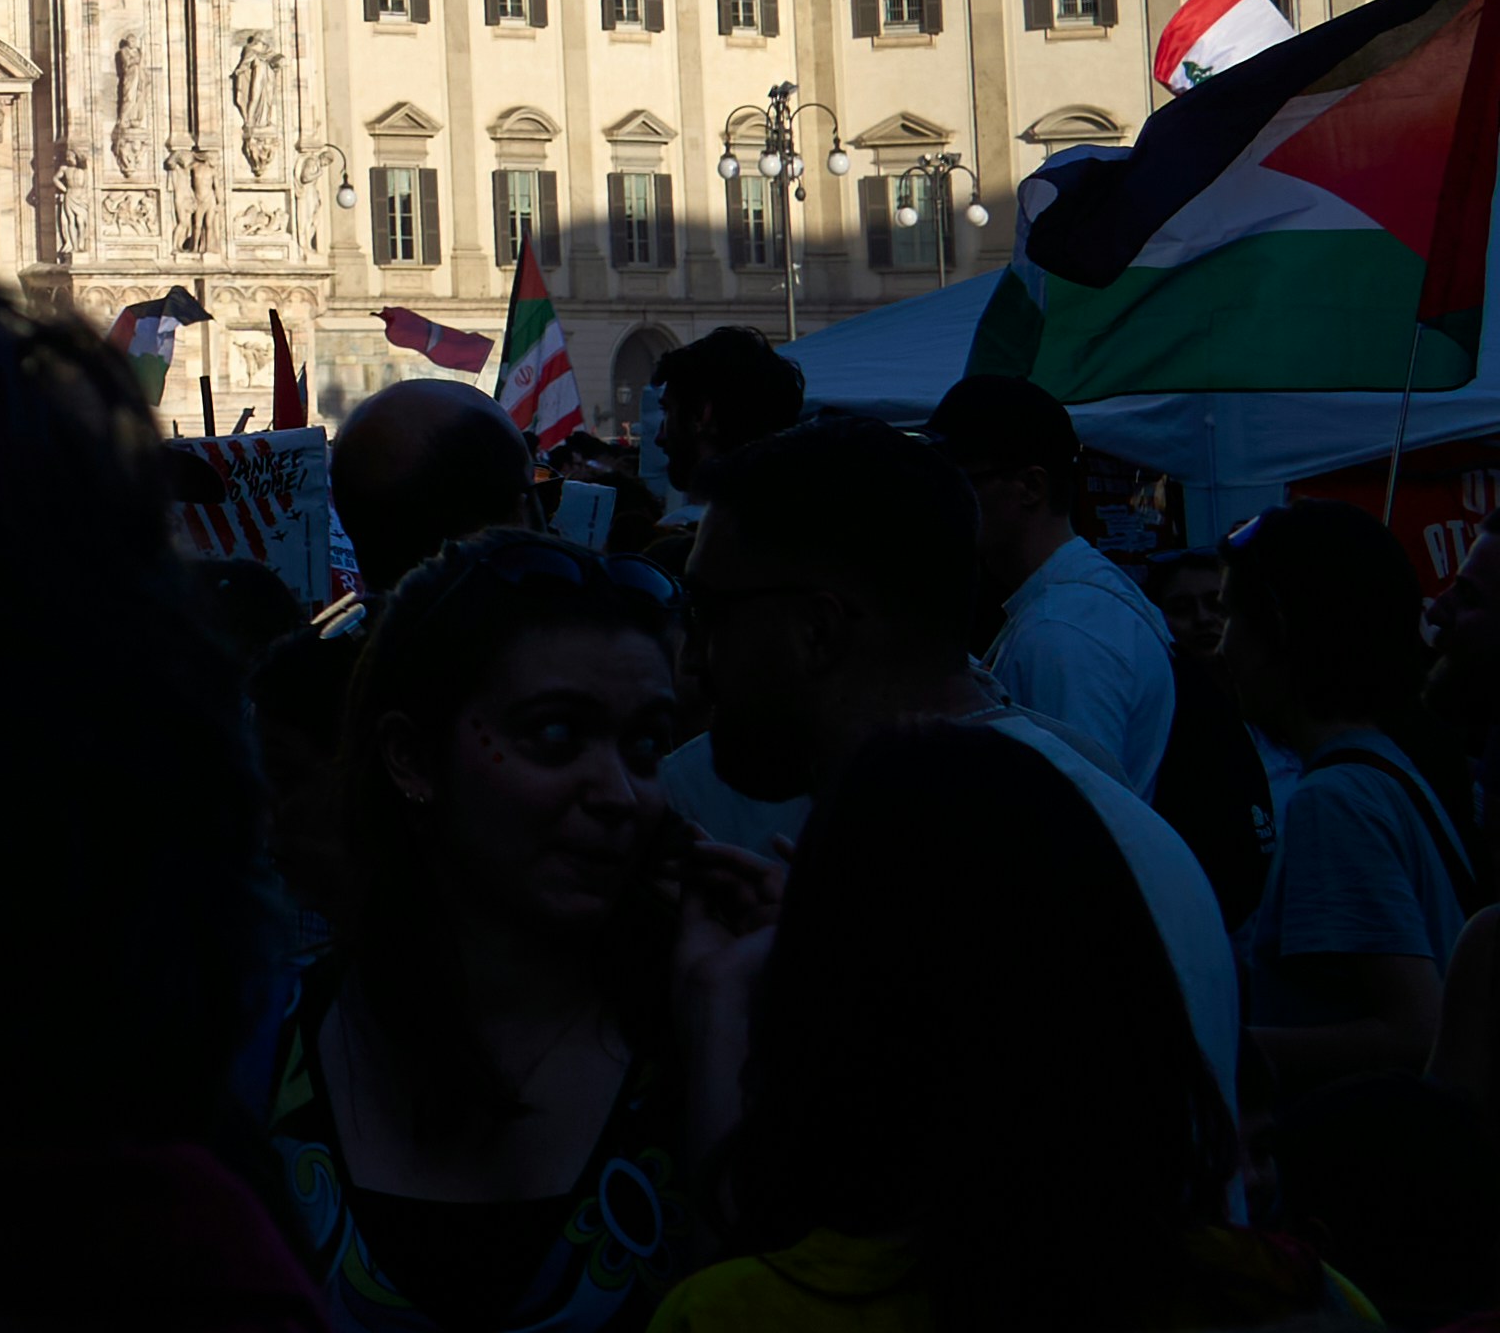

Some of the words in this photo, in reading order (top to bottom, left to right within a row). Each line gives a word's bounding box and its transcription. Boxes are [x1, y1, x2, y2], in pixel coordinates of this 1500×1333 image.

[226, 447, 306, 481] YANKEE
[229, 485, 241, 501] O
[246, 468, 308, 501] HOME!
